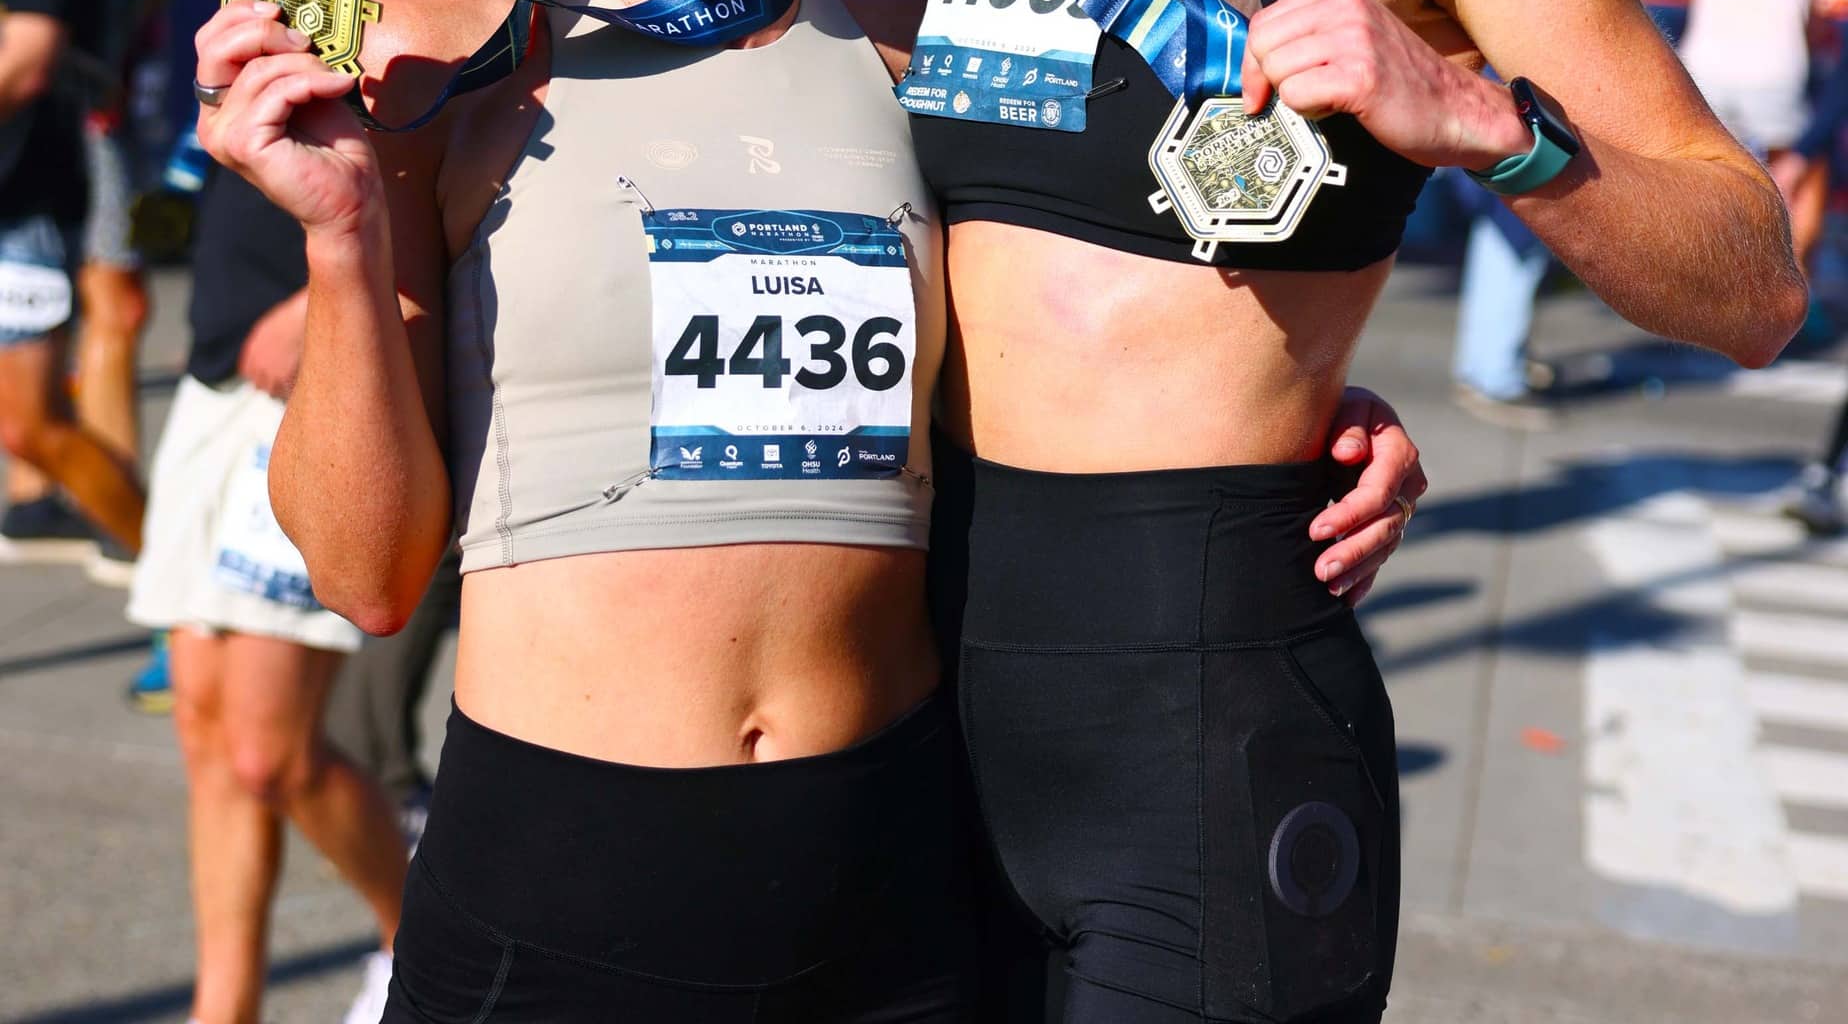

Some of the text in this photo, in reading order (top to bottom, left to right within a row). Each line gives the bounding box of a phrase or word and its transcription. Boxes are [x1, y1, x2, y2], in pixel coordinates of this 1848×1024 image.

[1044, 77, 1078, 87] PORTLAND
[931, 88, 947, 98] FOR
[999, 97, 1022, 106] REDEEM
[1000, 105, 1037, 122] BEER
[749, 223, 808, 232] PORTLAND
[752, 275, 825, 296] LUISA
[664, 314, 907, 392] 4436
[858, 453, 896, 462] PORTLAND
